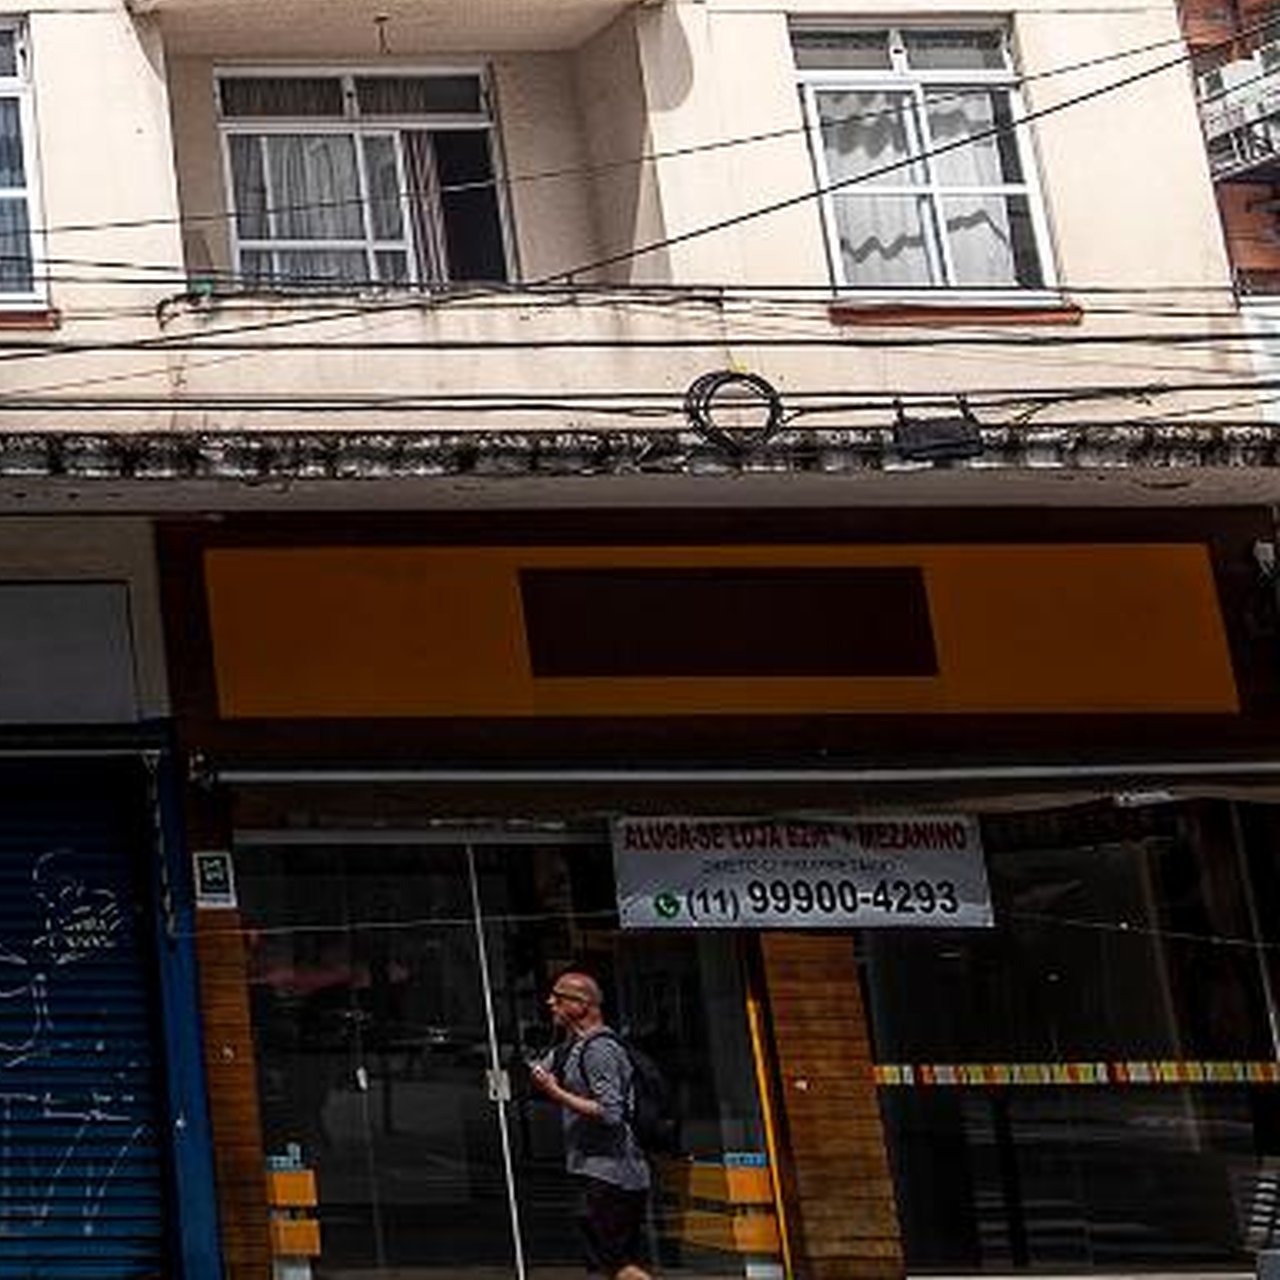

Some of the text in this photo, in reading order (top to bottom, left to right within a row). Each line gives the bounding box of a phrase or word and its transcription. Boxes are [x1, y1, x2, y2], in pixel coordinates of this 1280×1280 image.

[623, 823, 725, 851] ALUGA-SE
[857, 822, 967, 850] MEZANINO
[686, 880, 958, 920] (11) 99900-4293
